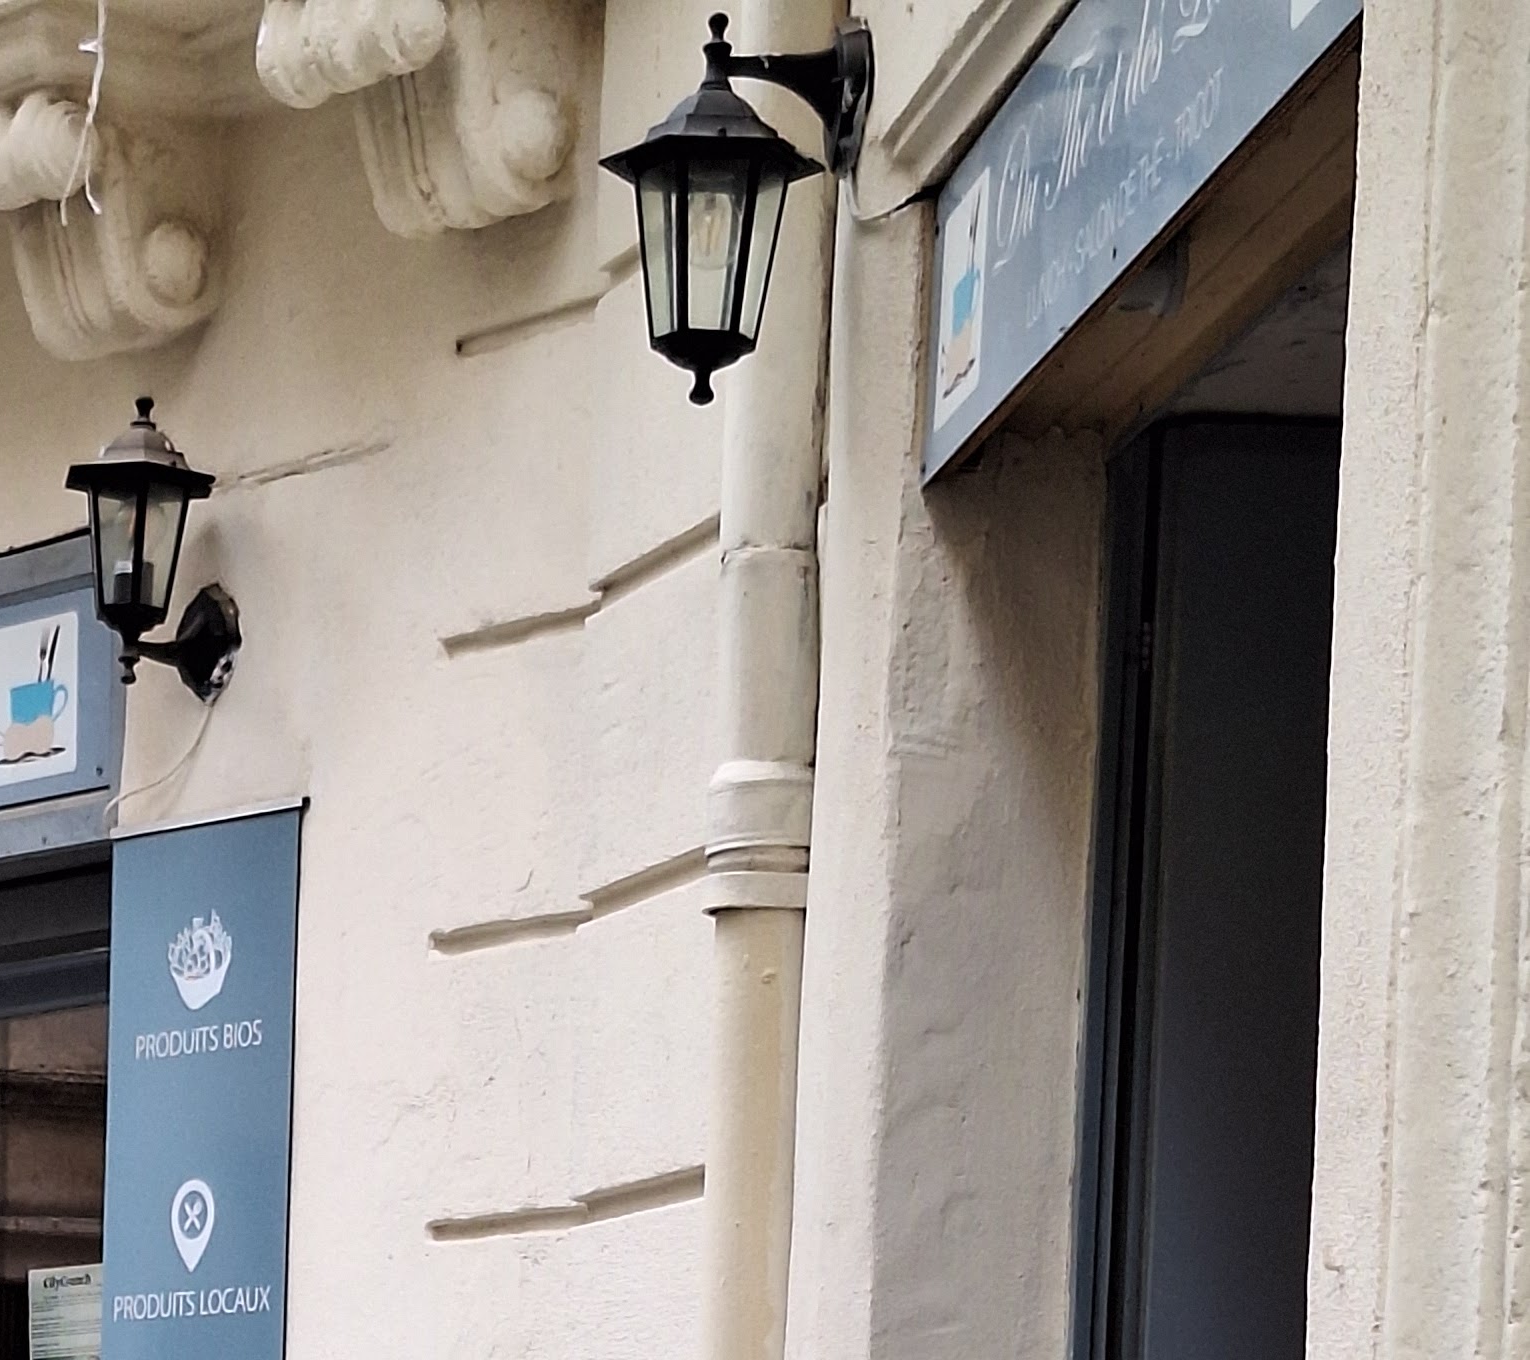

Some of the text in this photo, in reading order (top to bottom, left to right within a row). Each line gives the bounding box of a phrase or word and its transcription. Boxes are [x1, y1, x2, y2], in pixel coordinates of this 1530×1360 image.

[134, 1018, 263, 1061] PRODUITS BIOS
[113, 1285, 271, 1323] PRODUITS LOCAUX
